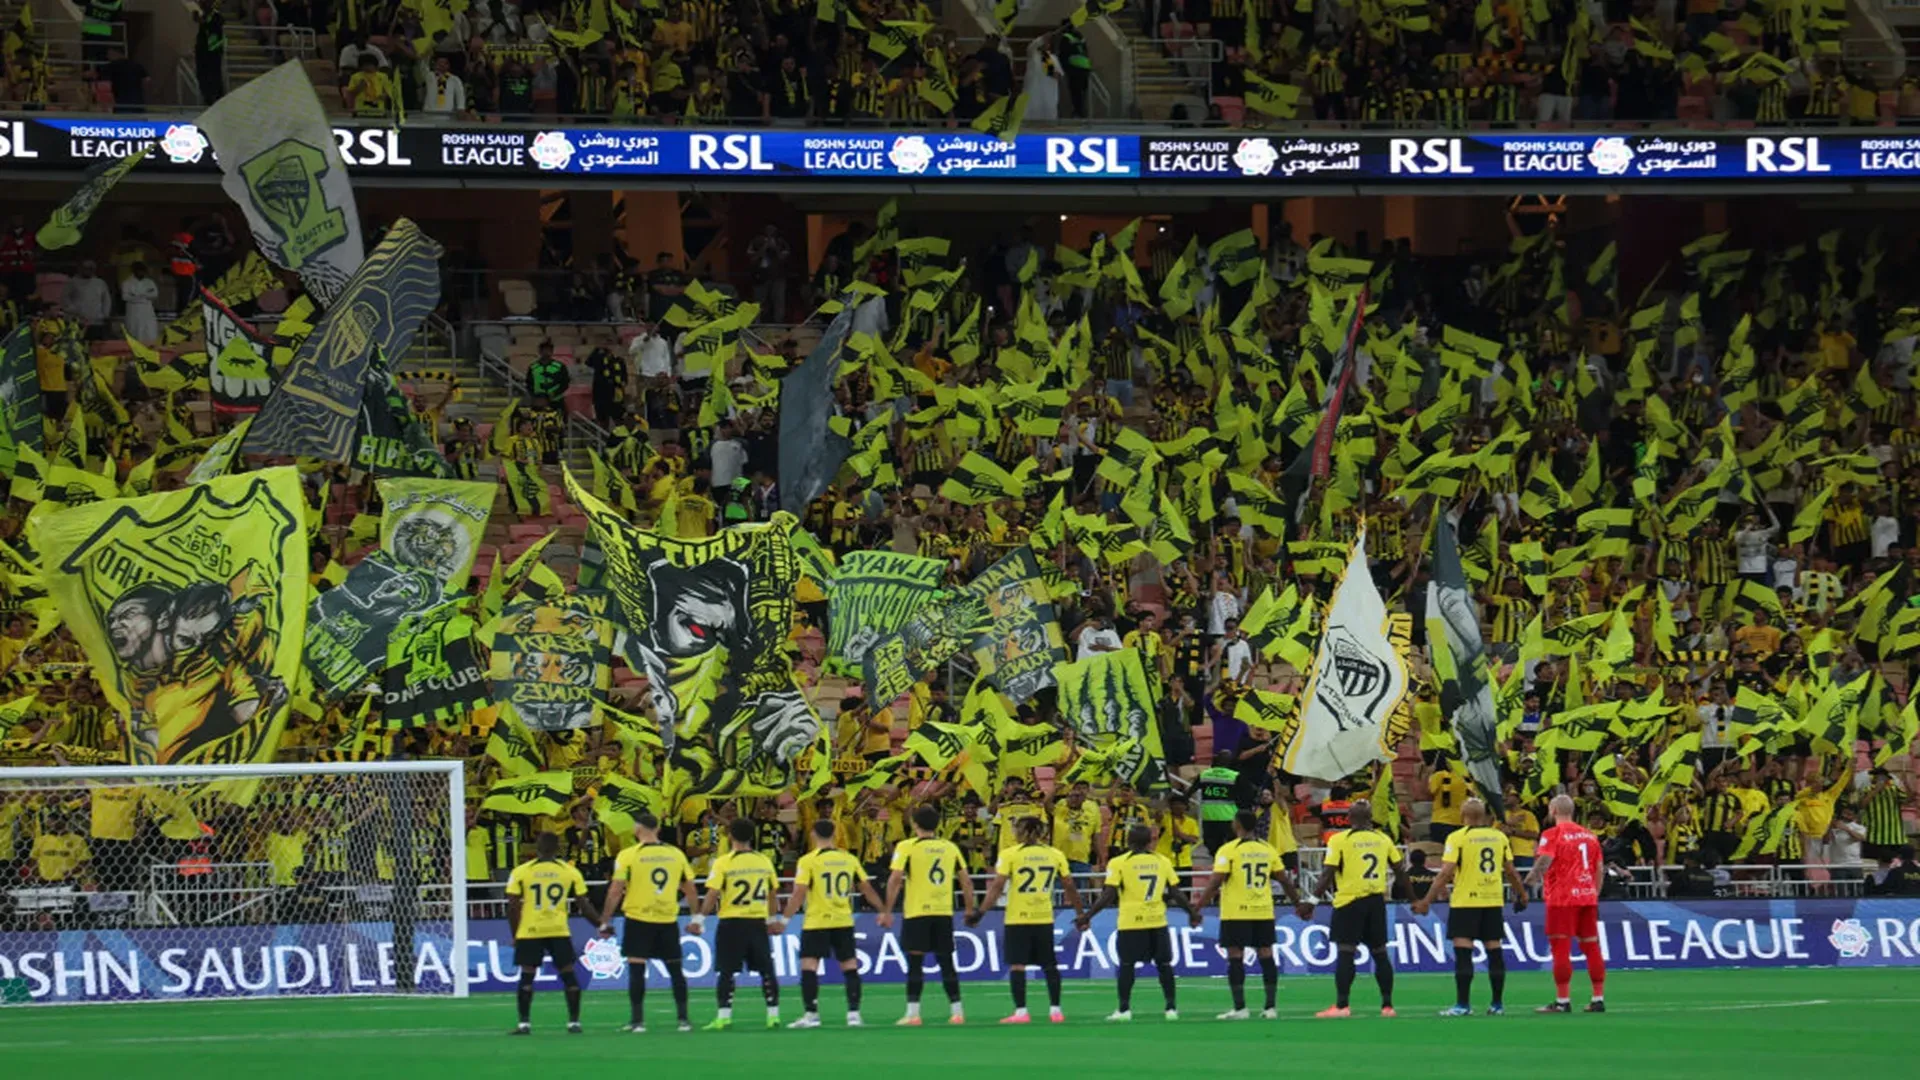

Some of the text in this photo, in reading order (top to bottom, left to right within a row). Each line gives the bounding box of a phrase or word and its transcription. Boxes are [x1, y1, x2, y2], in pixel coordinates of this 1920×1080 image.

[0, 121, 38, 157] SL
[71, 127, 155, 138] ROSHN SAUDI
[443, 134, 523, 145] ROSHN SAUDI
[579, 132, 659, 152] دوري روشن
[804, 139, 884, 149] ROSHN SAUDI
[71, 140, 155, 158] LEAGUE
[333, 129, 411, 166] RSL
[443, 147, 523, 165] LEAGUE
[690, 134, 773, 170] RSL
[937, 137, 1016, 155] دوري روشن
[1047, 138, 1129, 173] RSL
[1150, 142, 1228, 152] ROSHN SAUDI
[1281, 138, 1360, 157] دوري روشن
[1390, 139, 1474, 173] RSL
[1504, 142, 1584, 151] ROSHN SAUDI
[1636, 137, 1717, 156] دوري روشن
[1747, 137, 1830, 172] RSL
[1862, 140, 1920, 149] ROSHN SA
[579, 151, 659, 171] السعودي
[805, 152, 883, 169] LEAGUE
[937, 154, 1016, 175] السعودي
[1150, 154, 1228, 171] LEAGUE
[1281, 155, 1360, 177] السعودي
[1504, 154, 1583, 171] LEAGUE
[1636, 154, 1717, 175] السعودي
[1861, 152, 1920, 169] LEAG
[385, 666, 482, 704] ONE CLUB
[1204, 786, 1229, 798] 462
[1362, 853, 1379, 879] 2
[1479, 847, 1495, 874] 8
[1578, 843, 1589, 870] 1
[651, 868, 669, 893] 9
[929, 859, 945, 885] 6
[1018, 866, 1055, 893] 27
[1241, 862, 1268, 889] 15
[530, 883, 564, 909] 19
[732, 879, 769, 906] 24
[821, 872, 851, 898] 10
[1139, 874, 1158, 901] 7
[1622, 918, 1810, 962] LEAGUE
[853, 930, 1000, 976] SADI
[160, 944, 332, 993] SAUDI
